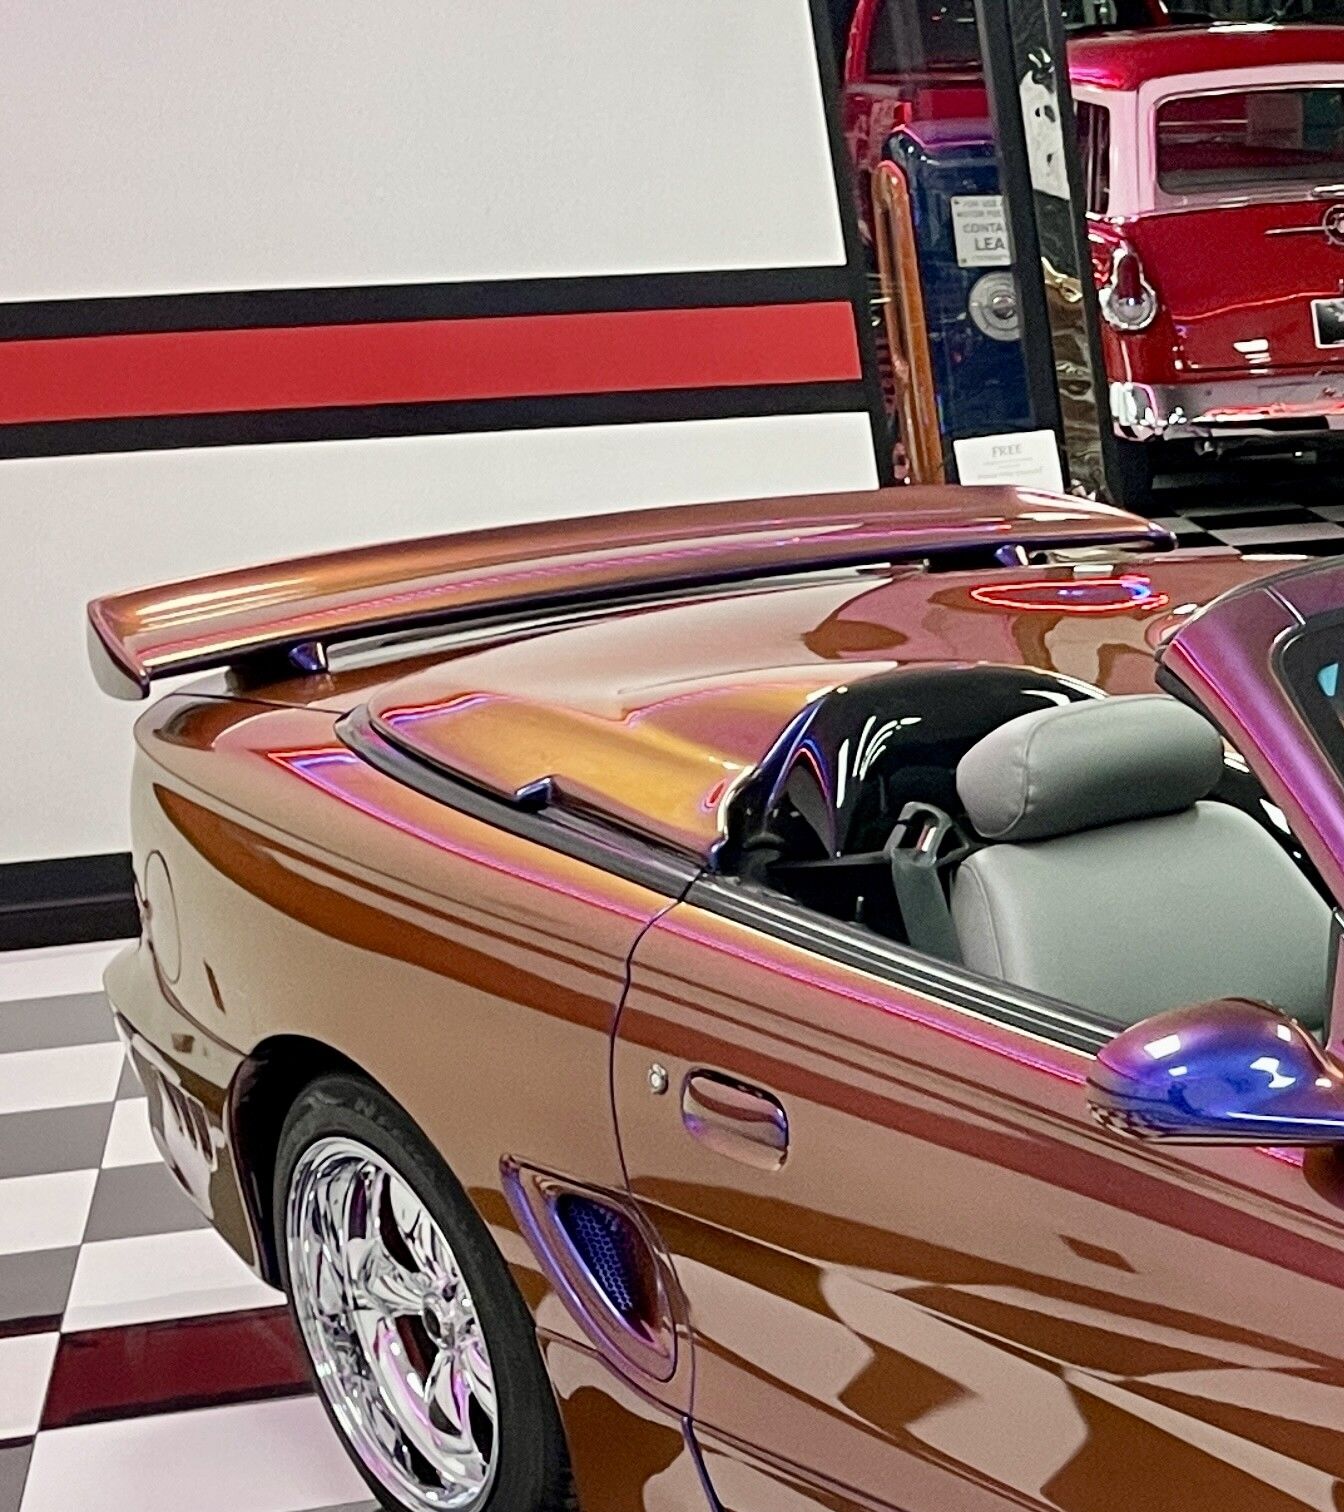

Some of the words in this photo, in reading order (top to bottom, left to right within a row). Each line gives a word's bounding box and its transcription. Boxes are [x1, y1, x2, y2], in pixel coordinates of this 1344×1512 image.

[963, 222, 1004, 234] CONTA
[974, 237, 1006, 251] LEA
[992, 444, 1022, 458] FREE
